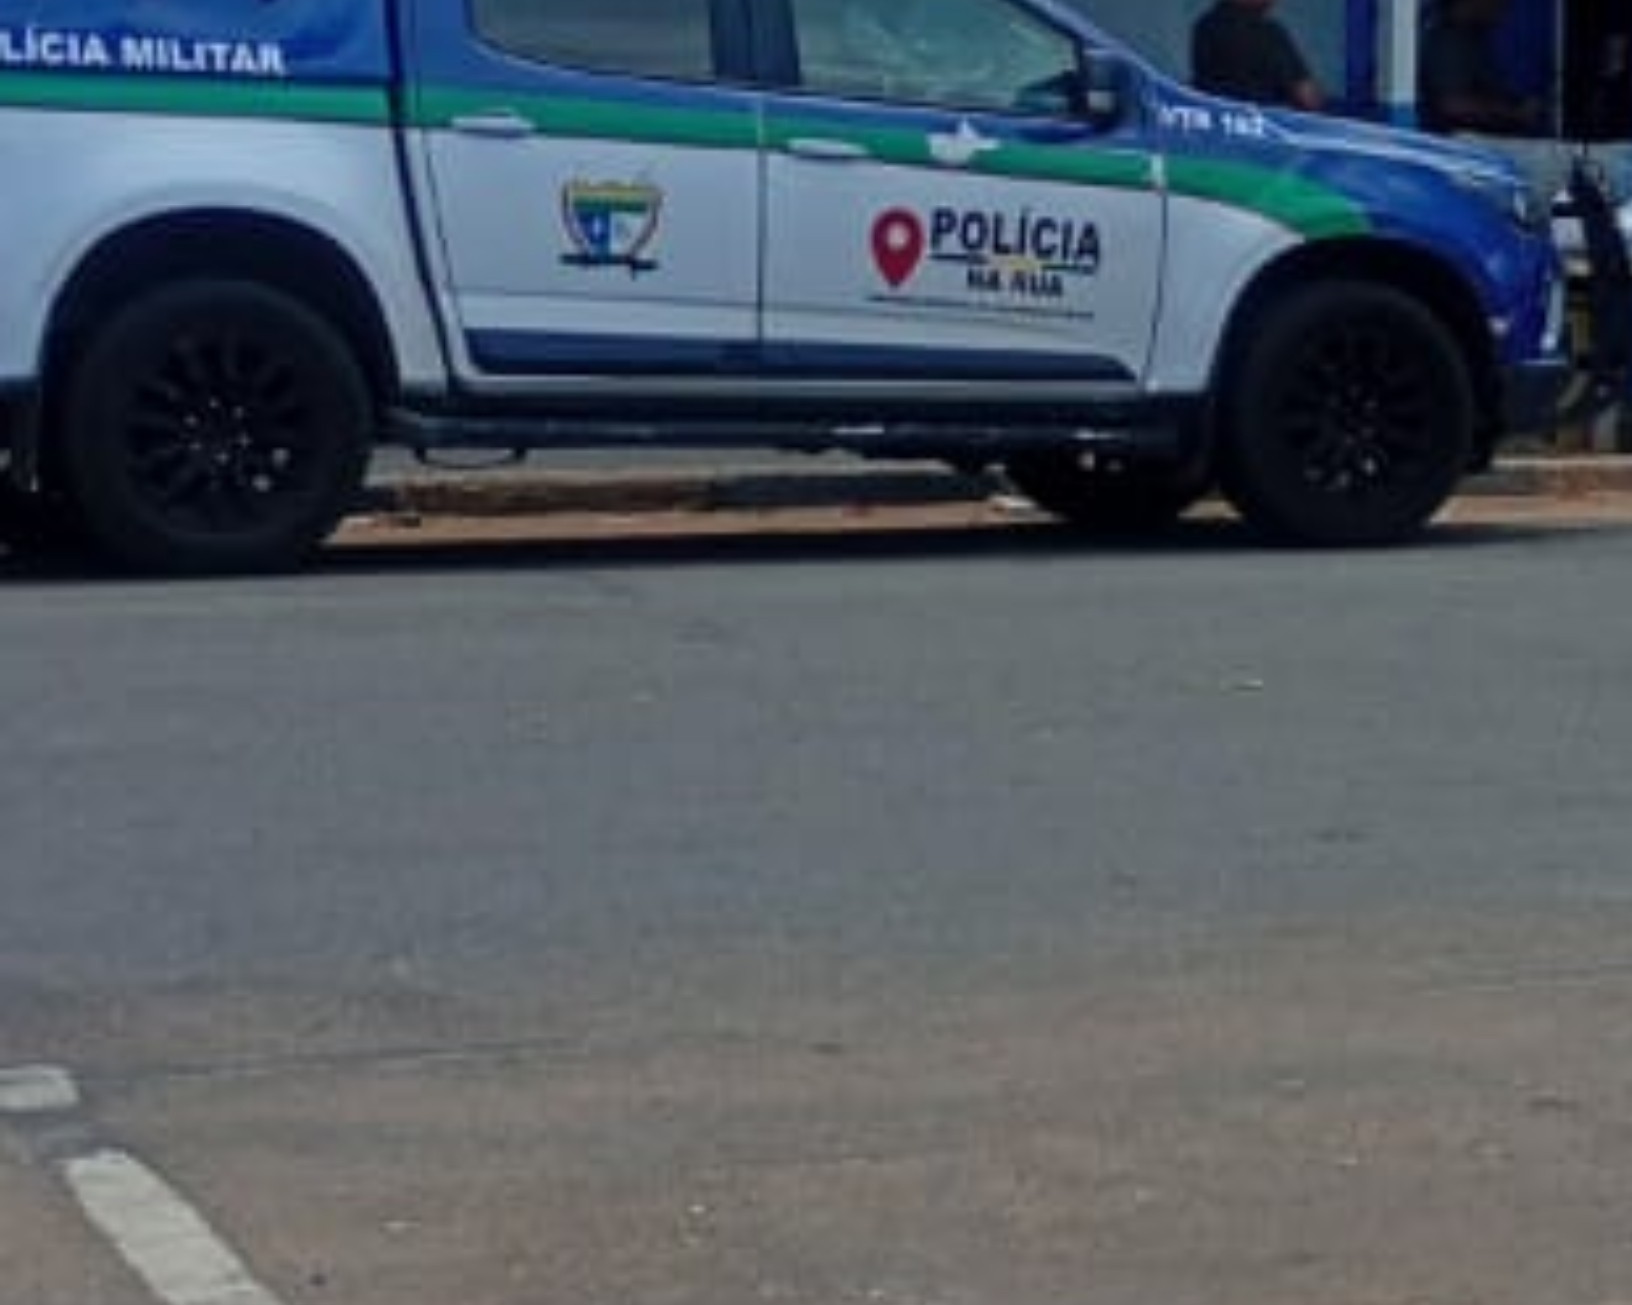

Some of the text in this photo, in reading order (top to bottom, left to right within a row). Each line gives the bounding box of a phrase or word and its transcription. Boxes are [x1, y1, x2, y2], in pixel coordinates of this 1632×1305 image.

[117, 34, 287, 77] MILITAR
[931, 204, 1101, 270] POLÍCIA
[966, 267, 1002, 293] NA
